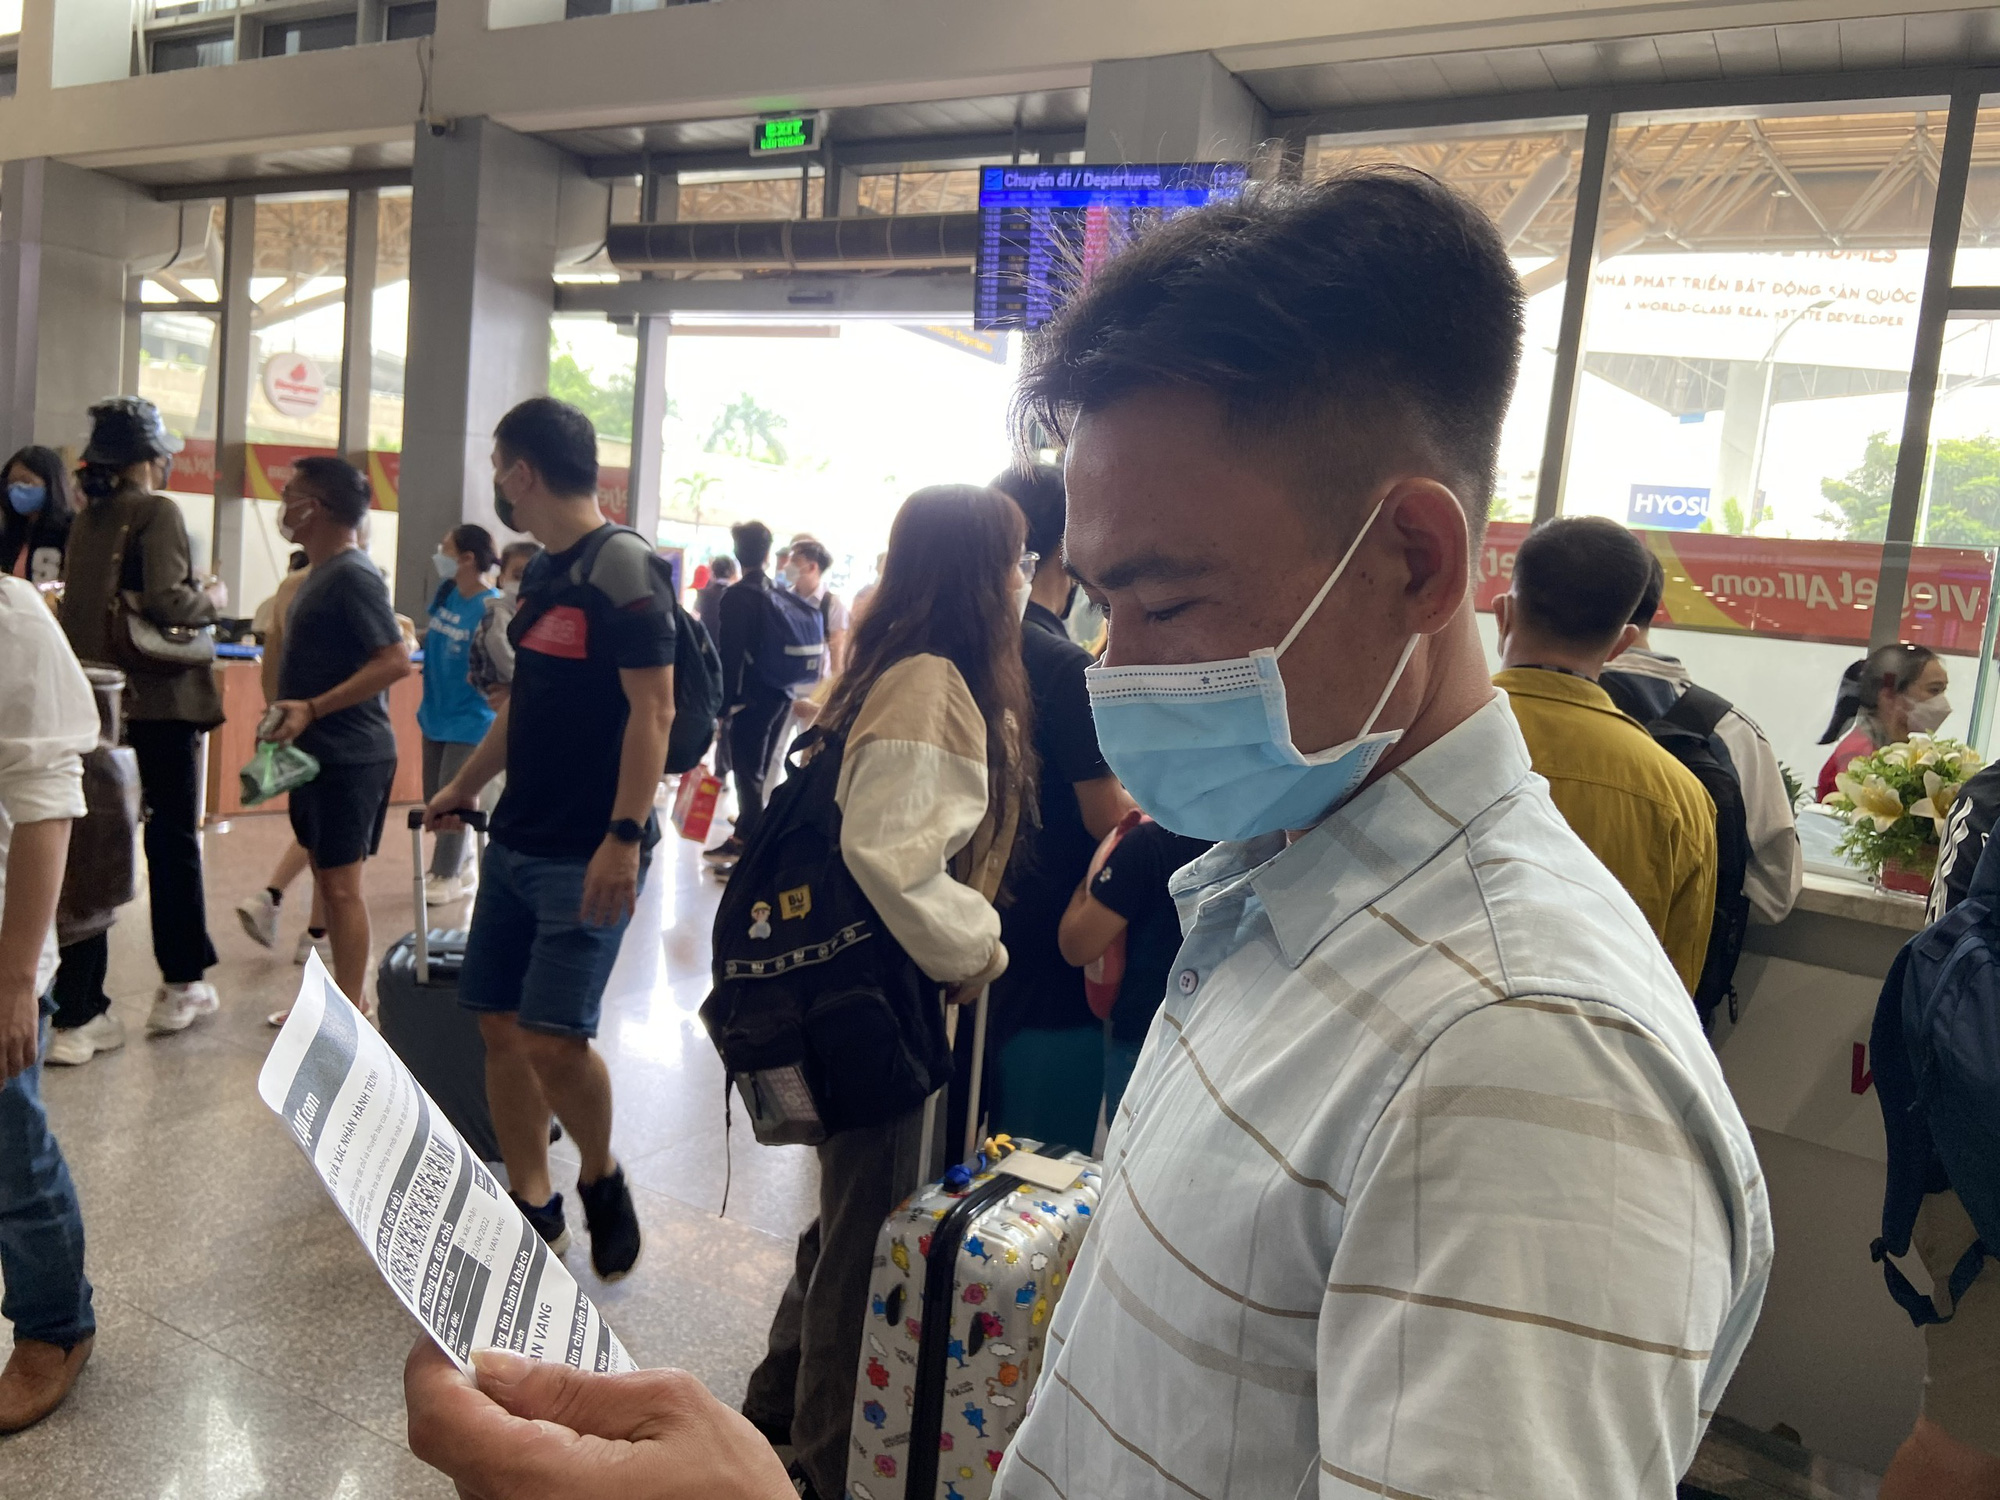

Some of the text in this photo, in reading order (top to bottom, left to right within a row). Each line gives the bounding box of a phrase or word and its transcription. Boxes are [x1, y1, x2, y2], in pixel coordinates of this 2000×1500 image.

[1057, 172, 1071, 187] đi
[1073, 173, 1081, 187] /
[1083, 171, 1161, 190] Departures
[1638, 301, 1732, 315] WORLD-CLASS
[1827, 312, 1904, 326] DEVELOPER
[333, 1145, 346, 1165] XÁC
[340, 1119, 358, 1148] NHẬN
[351, 1092, 371, 1121] HÀNH
[384, 1207, 396, 1229] (số
[390, 1189, 404, 1210] vé):
[440, 1219, 454, 1243] chỗ
[434, 1242, 447, 1261] đặt
[428, 1262, 440, 1279] tin
[446, 1269, 455, 1286] chỗ
[512, 1249, 530, 1283] khách
[421, 1280, 438, 1309] Thông
[442, 1285, 452, 1299] đặt
[447, 1217, 490, 1348] Ngày đặt: 21/04/2022
[459, 1216, 506, 1360] Tên: DO, VAN VANG
[438, 1298, 448, 1315] thái
[503, 1286, 519, 1314] hành
[499, 1316, 511, 1331] tin
[534, 1302, 552, 1340] VANG
[568, 1348, 581, 1366] tin
[597, 1350, 609, 1372] Ngày
